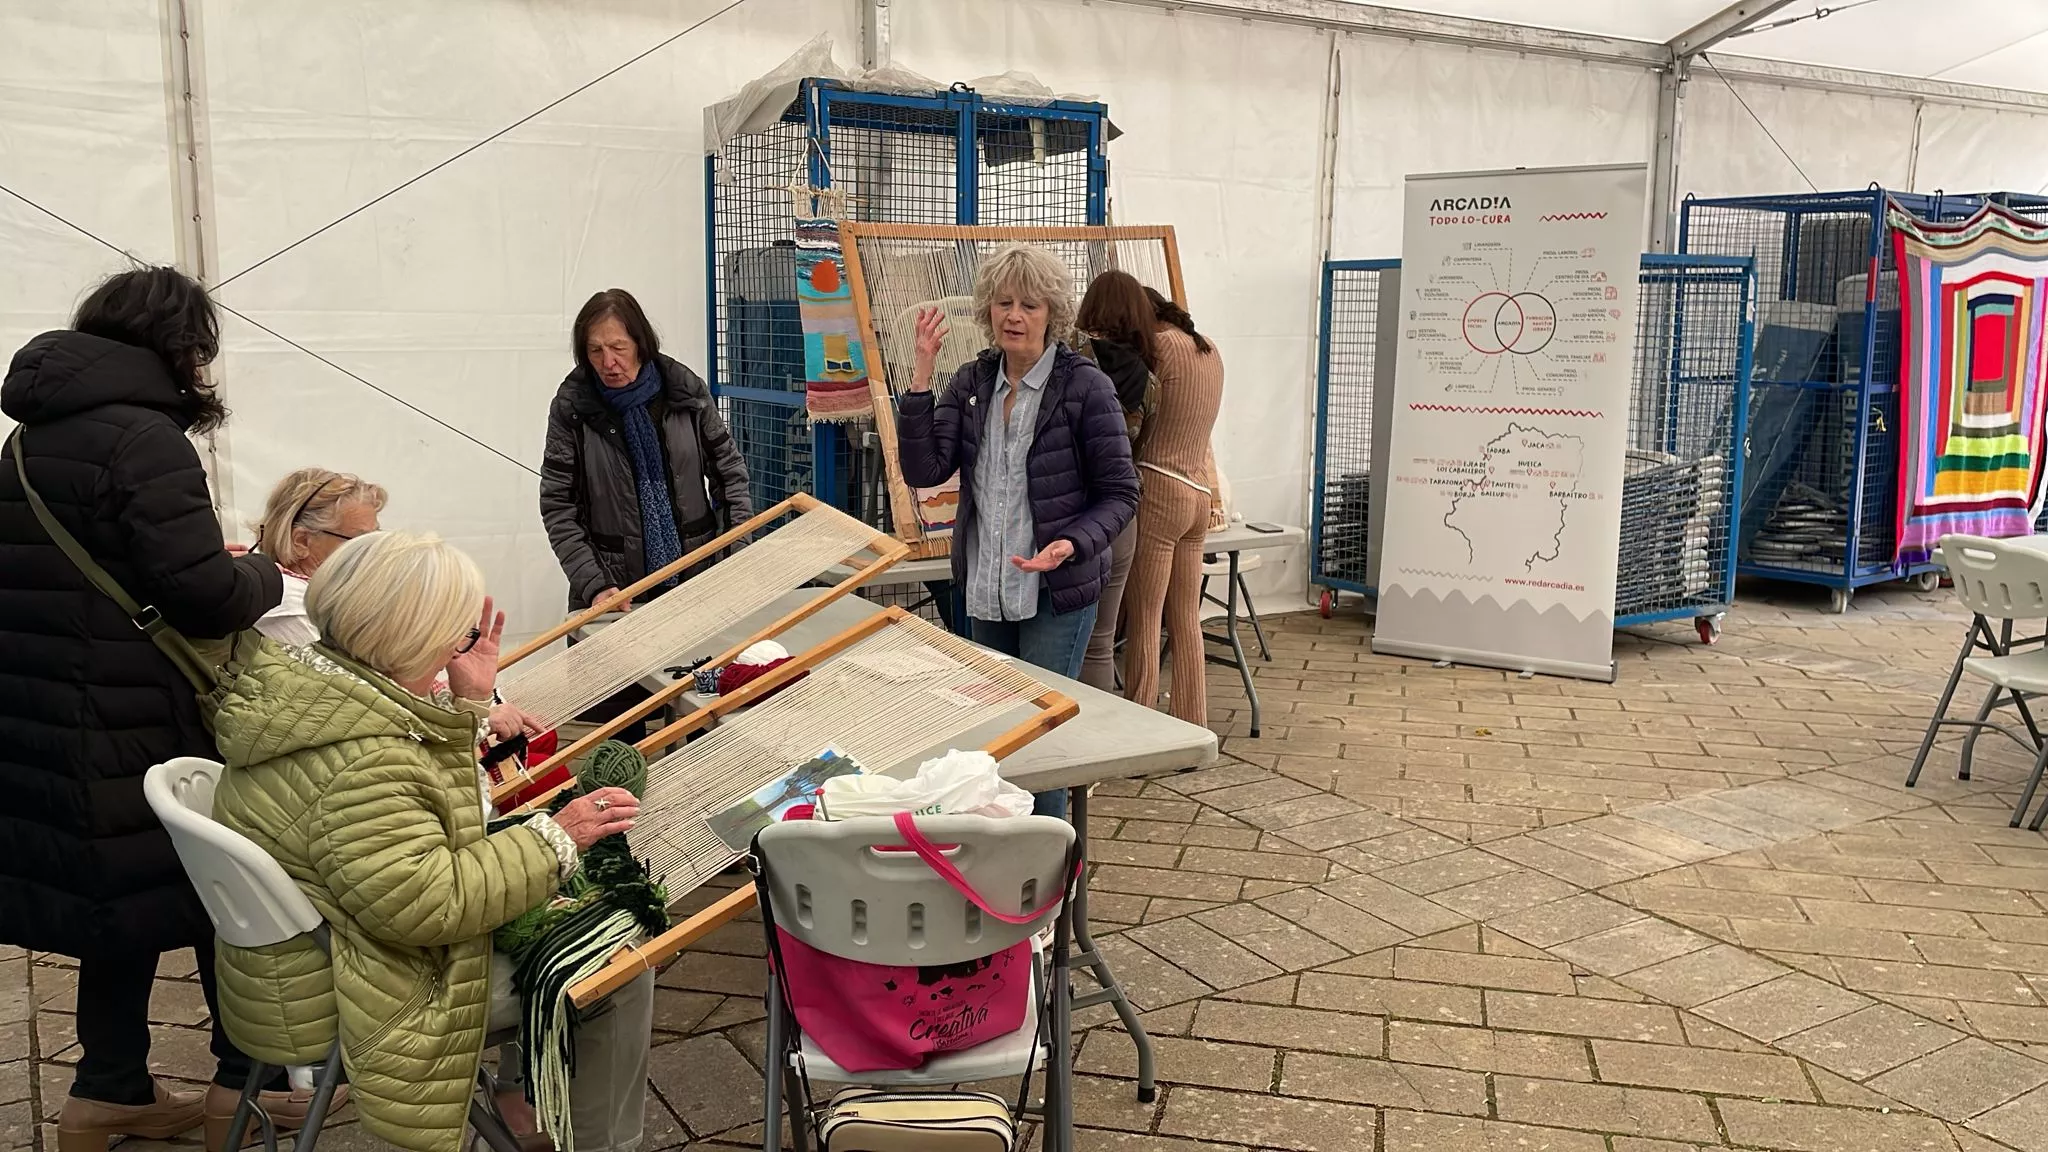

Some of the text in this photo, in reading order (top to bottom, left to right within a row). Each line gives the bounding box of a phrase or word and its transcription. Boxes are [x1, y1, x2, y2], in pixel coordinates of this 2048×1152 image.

[1430, 215, 1511, 226] TODO LO-CURA
[1504, 578, 1585, 591] www.redarcadia.es
[909, 1003, 988, 1040] Creativa
